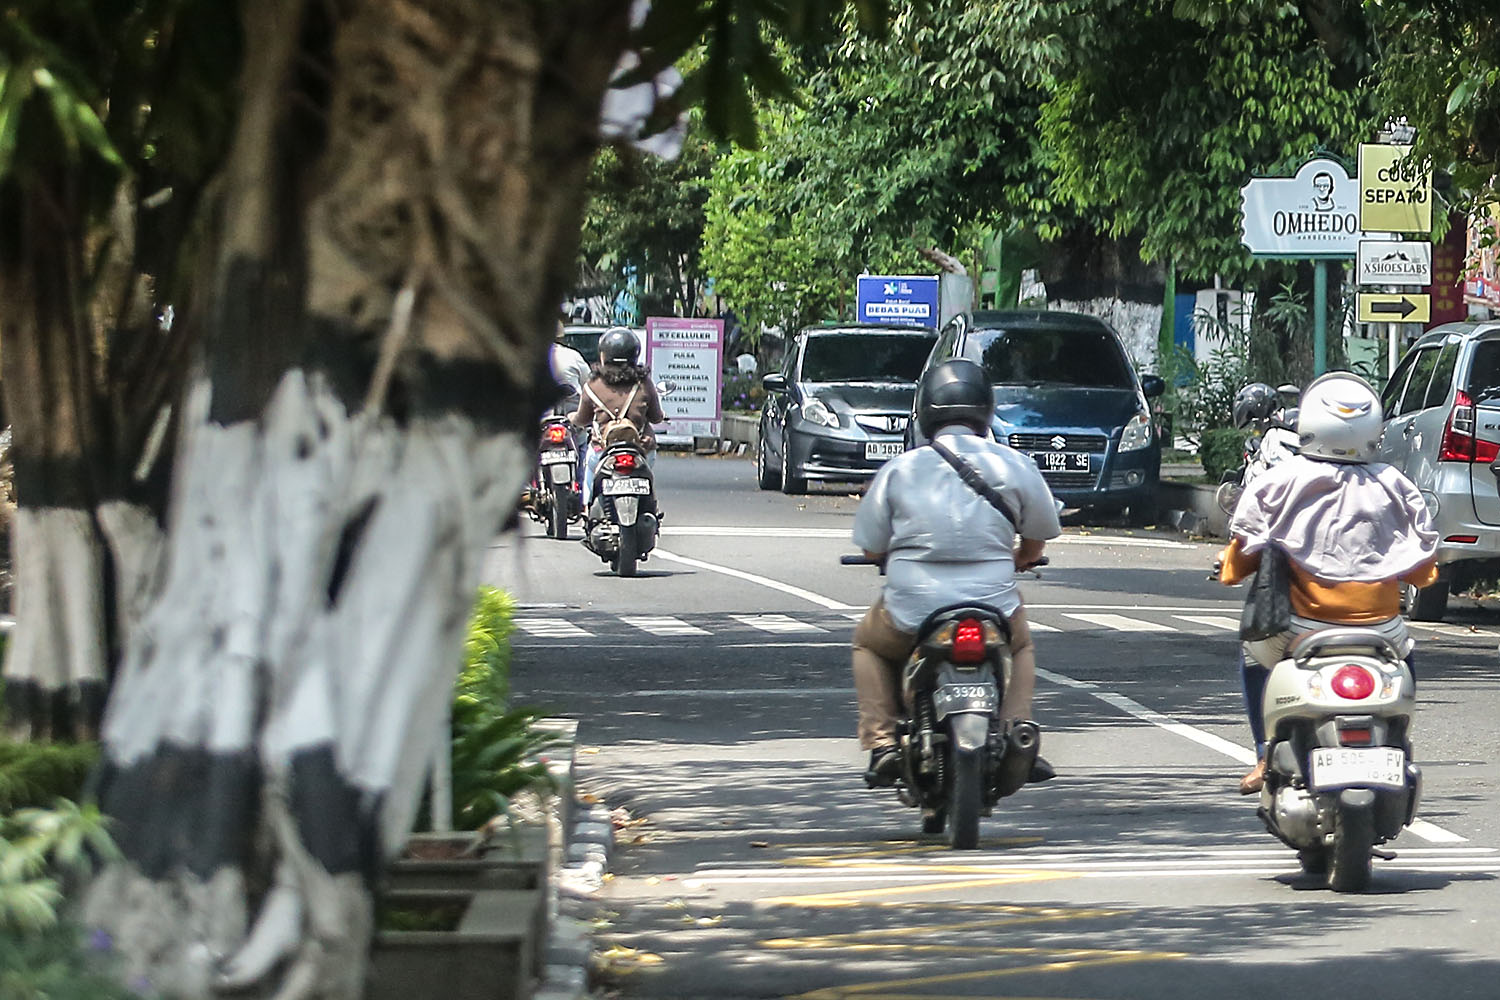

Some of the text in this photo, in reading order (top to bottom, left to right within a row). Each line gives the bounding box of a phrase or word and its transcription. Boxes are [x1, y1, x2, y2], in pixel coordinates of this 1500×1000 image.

[1365, 188, 1428, 204] SEPATU
[1273, 210, 1367, 237] OMHEDO
[902, 306, 927, 314] PUAS
[1075, 453, 1088, 467] SE
[1317, 752, 1334, 768] AB
[1386, 752, 1402, 768] FV
